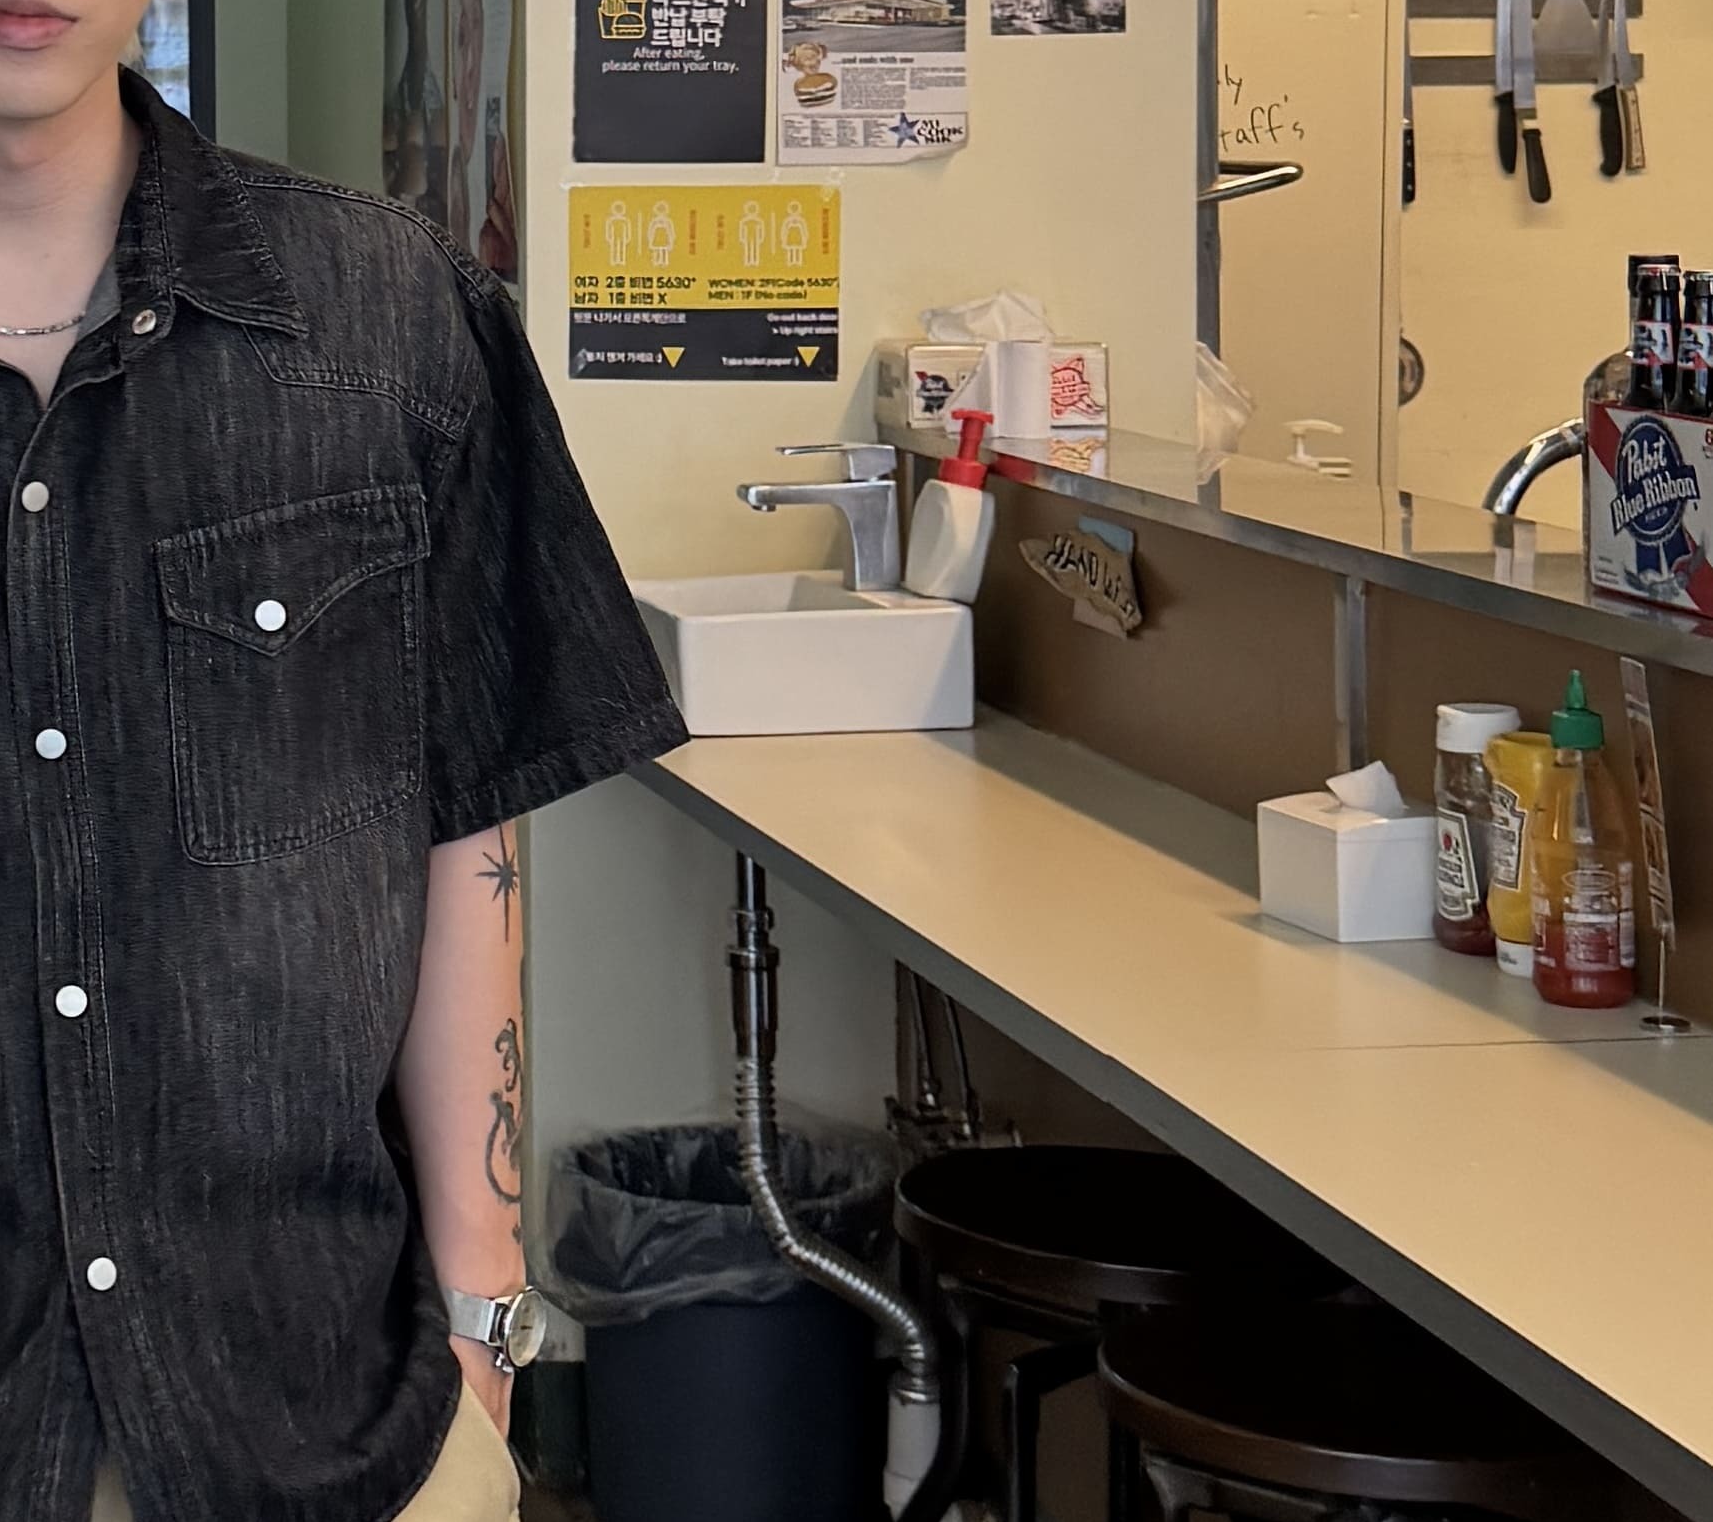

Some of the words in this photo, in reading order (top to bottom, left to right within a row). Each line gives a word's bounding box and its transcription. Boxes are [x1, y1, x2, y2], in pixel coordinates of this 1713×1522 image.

[651, 7, 688, 27] 반납
[690, 7, 727, 28] 부탁
[650, 27, 724, 48] 드립니다
[633, 47, 662, 59] After
[601, 60, 641, 74] please
[643, 61, 680, 72] return
[683, 62, 710, 74] your
[713, 60, 740, 74] tray.
[1219, 94, 1305, 152] taff's
[1621, 434, 1667, 485] Pabst
[1612, 493, 1646, 533] Blue
[1642, 469, 1697, 509] Ribbon
